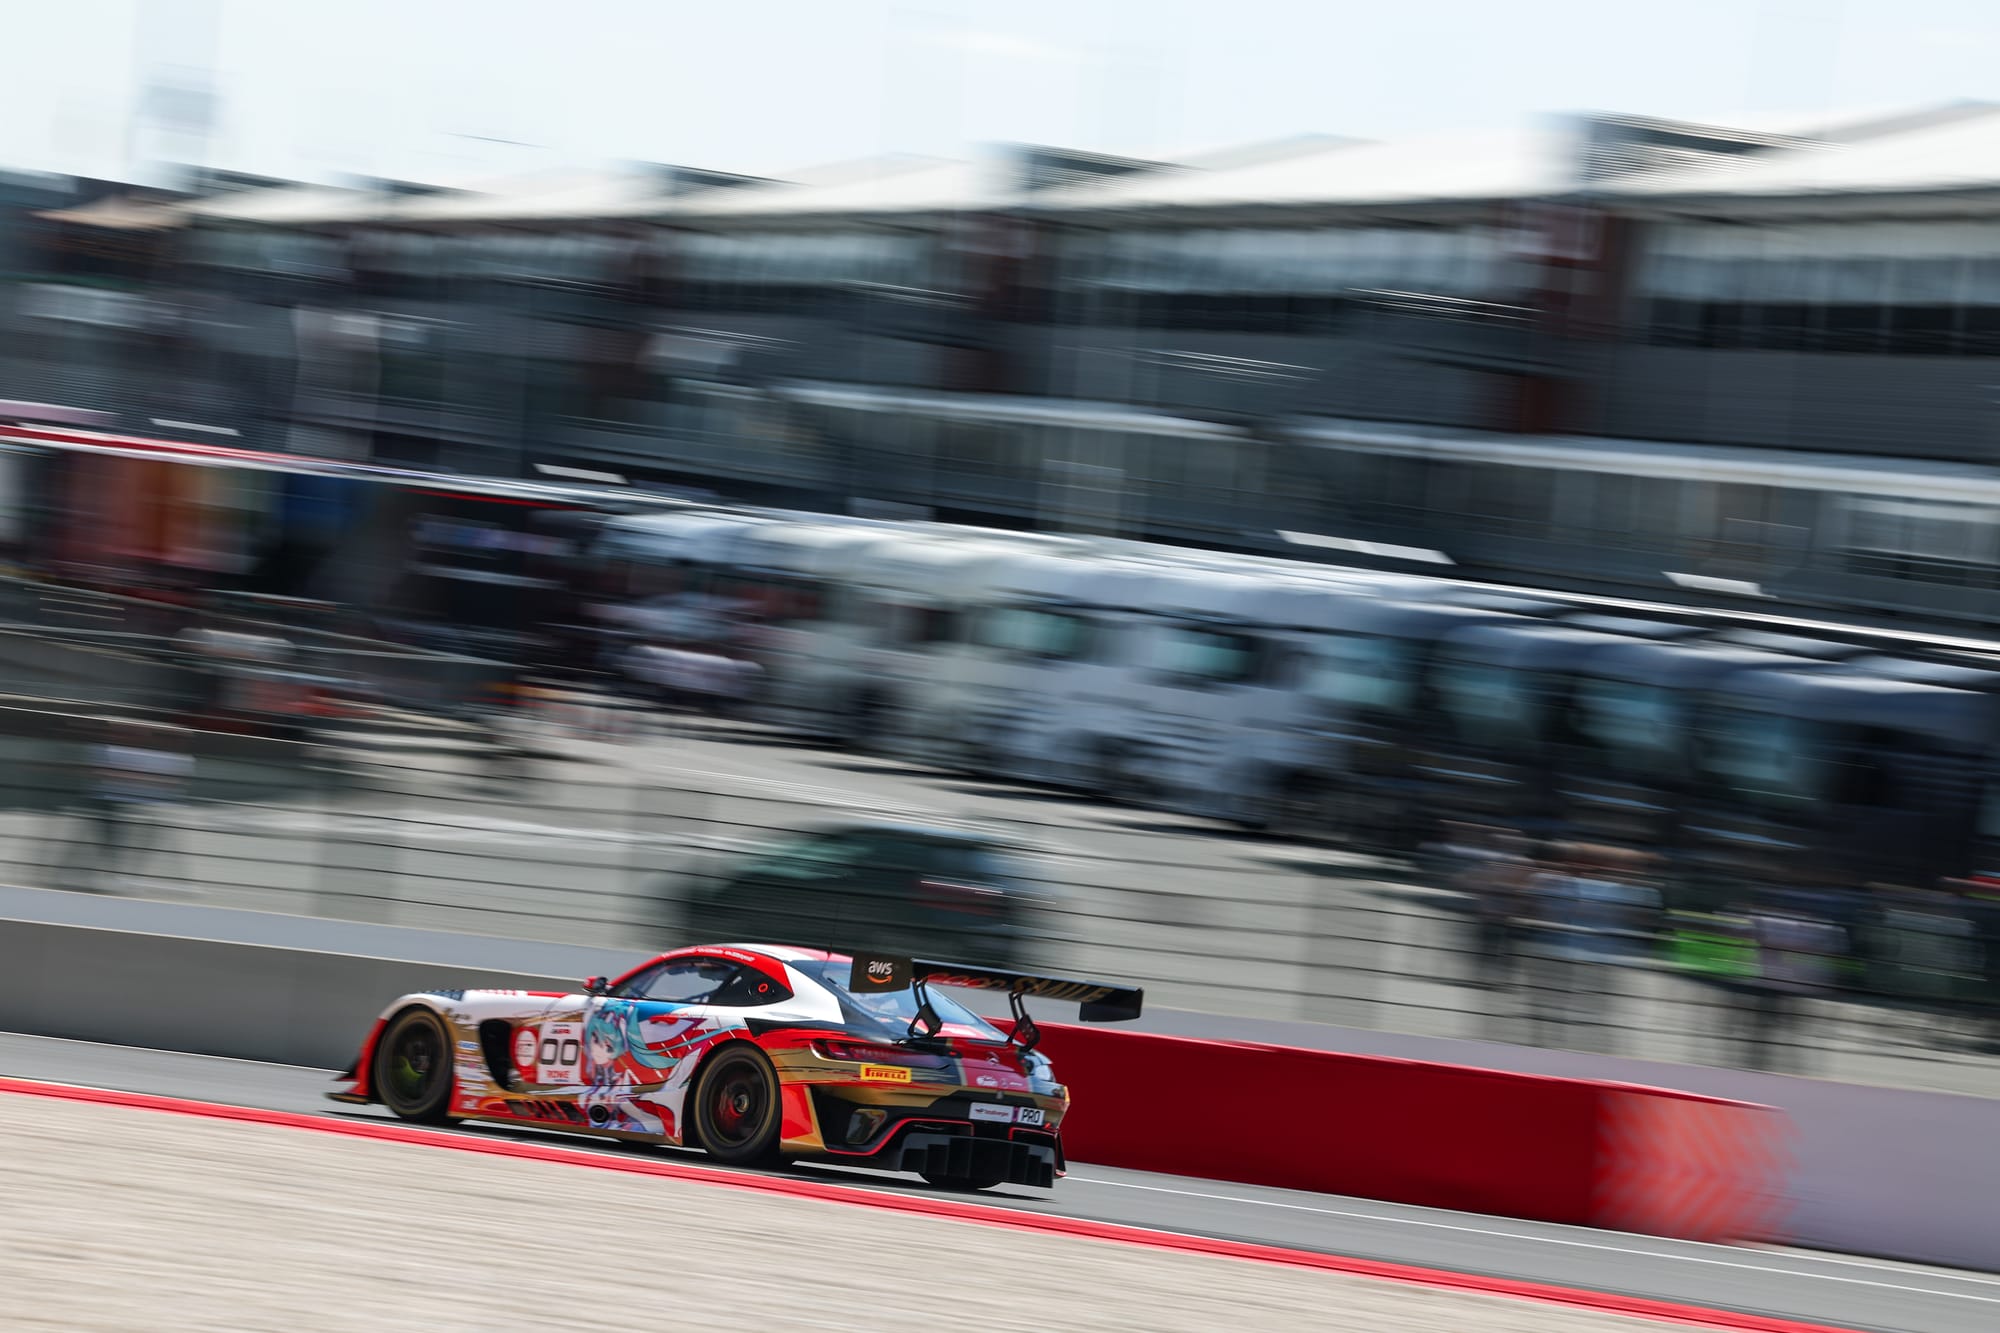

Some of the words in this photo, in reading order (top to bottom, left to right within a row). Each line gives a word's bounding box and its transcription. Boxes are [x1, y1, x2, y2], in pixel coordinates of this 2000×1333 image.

[868, 960, 893, 976] aws
[541, 1038, 578, 1065] 00
[865, 1067, 907, 1080] PIRELLI
[1022, 1108, 1041, 1123] PRO
